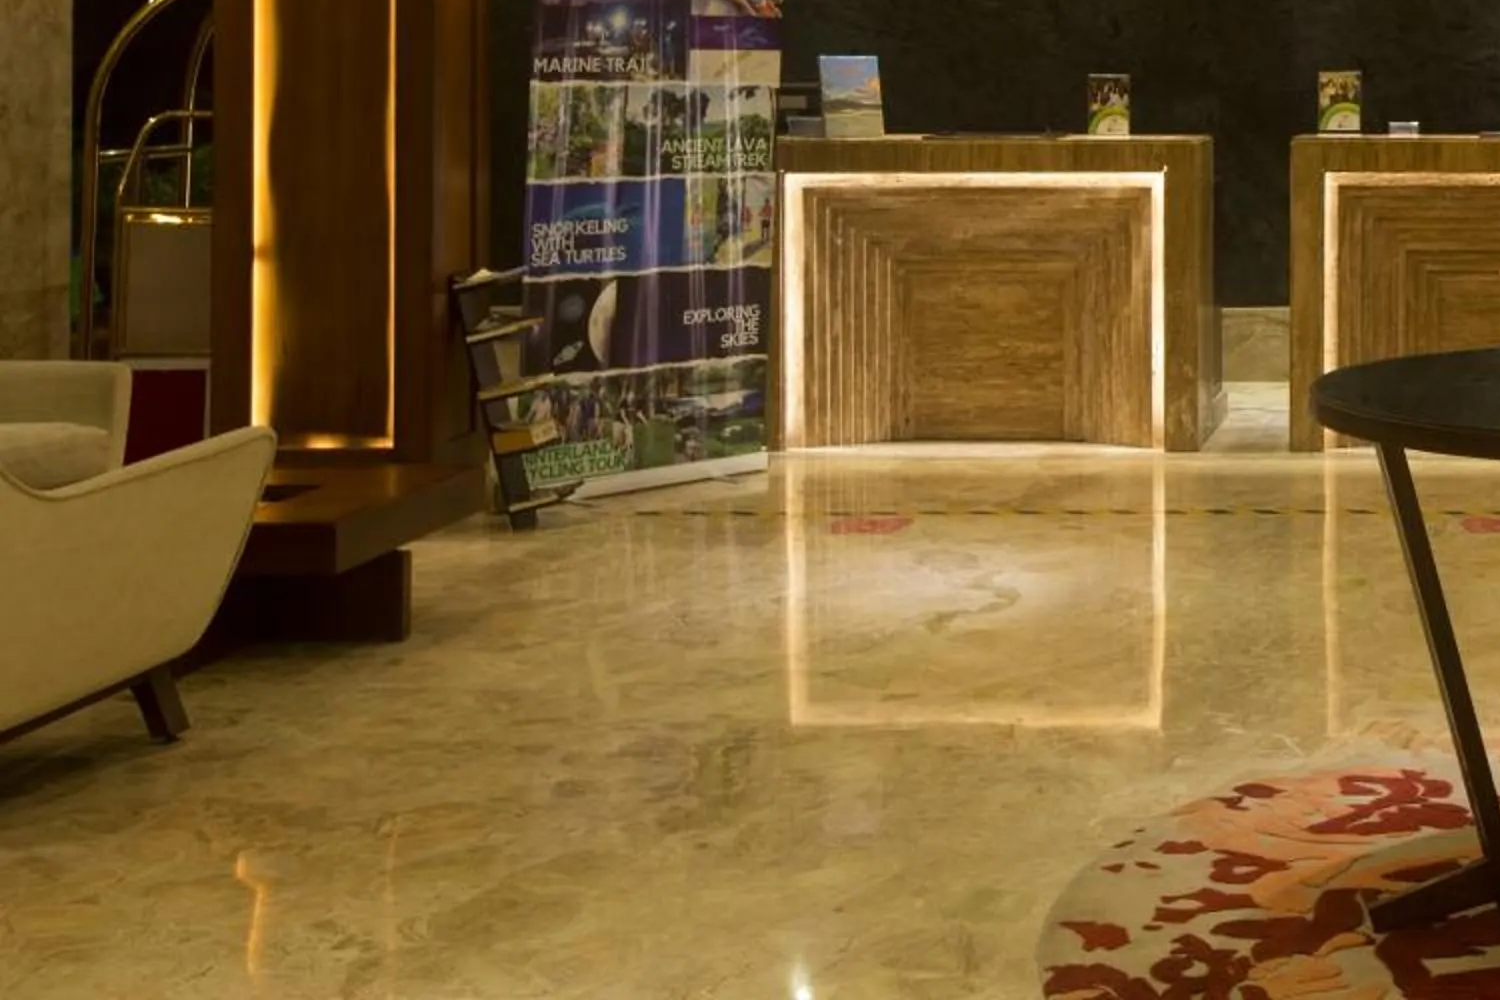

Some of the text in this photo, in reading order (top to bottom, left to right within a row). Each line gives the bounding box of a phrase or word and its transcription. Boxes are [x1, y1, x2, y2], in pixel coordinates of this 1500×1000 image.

[533, 56, 601, 73] MARINE
[532, 218, 630, 239] SNORKELING
[531, 234, 575, 252] WITH
[531, 245, 628, 267] SEA TURTLES
[683, 303, 761, 326] EXPLORING
[736, 318, 760, 334] THE
[720, 332, 760, 350] SKIES
[529, 459, 583, 479] YCLING
